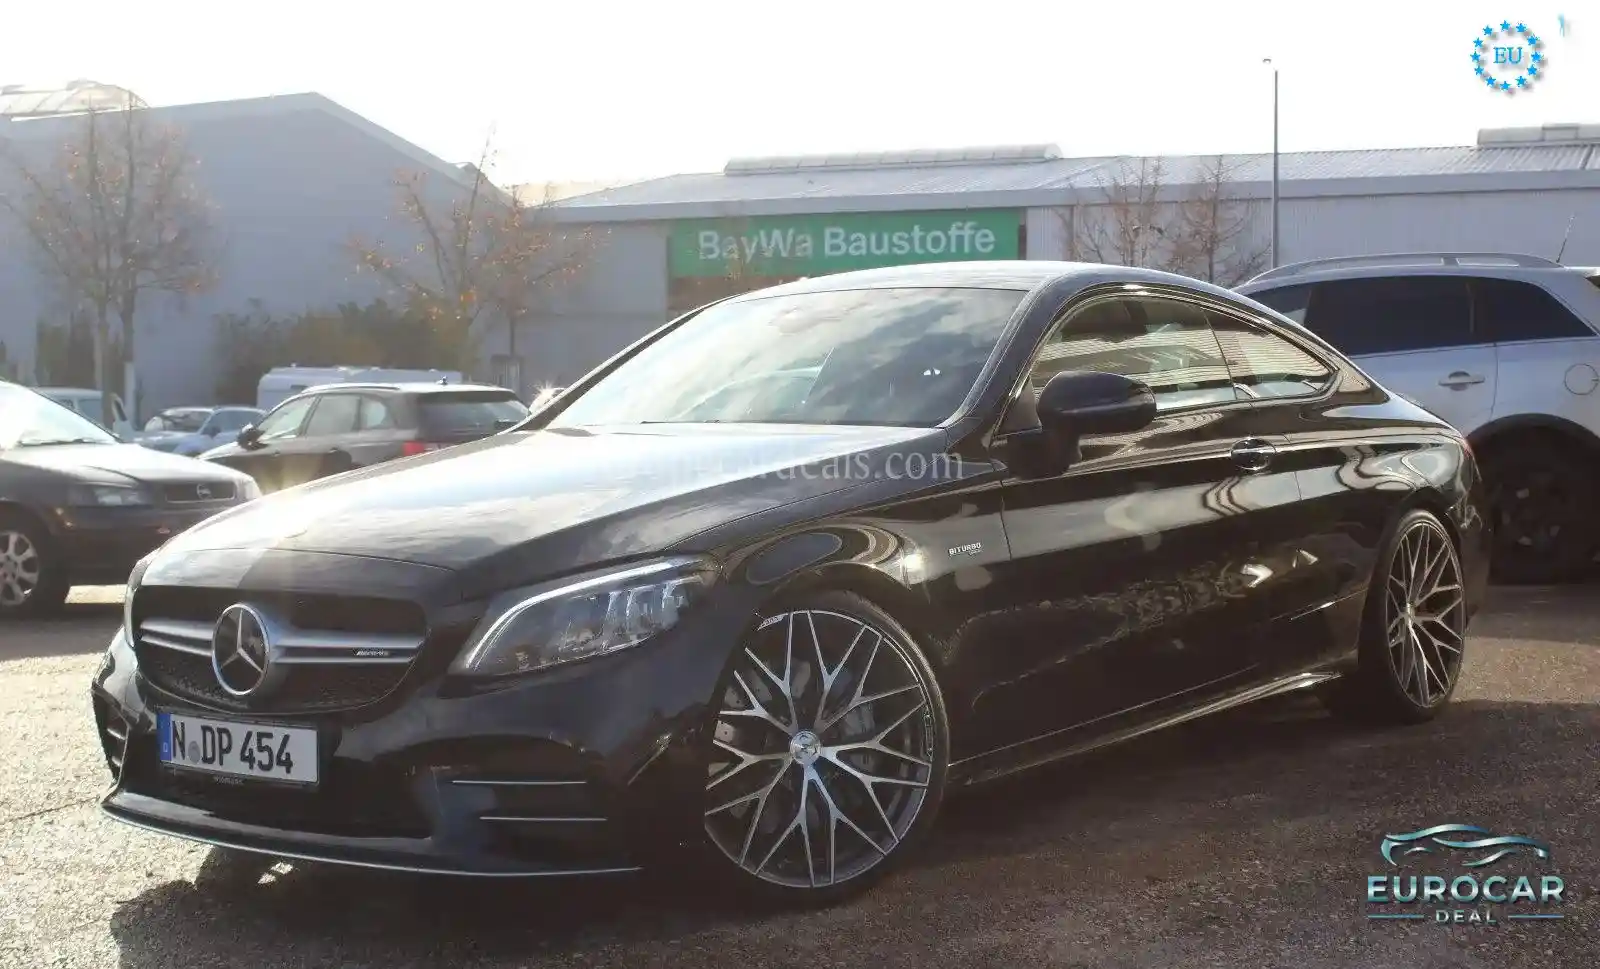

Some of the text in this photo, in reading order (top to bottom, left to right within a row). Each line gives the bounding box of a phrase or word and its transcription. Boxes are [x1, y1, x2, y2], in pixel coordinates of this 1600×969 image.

[698, 222, 996, 264] BayWa Baustoffe
[949, 542, 981, 555] BITURBO
[172, 721, 294, 774] N DP 454
